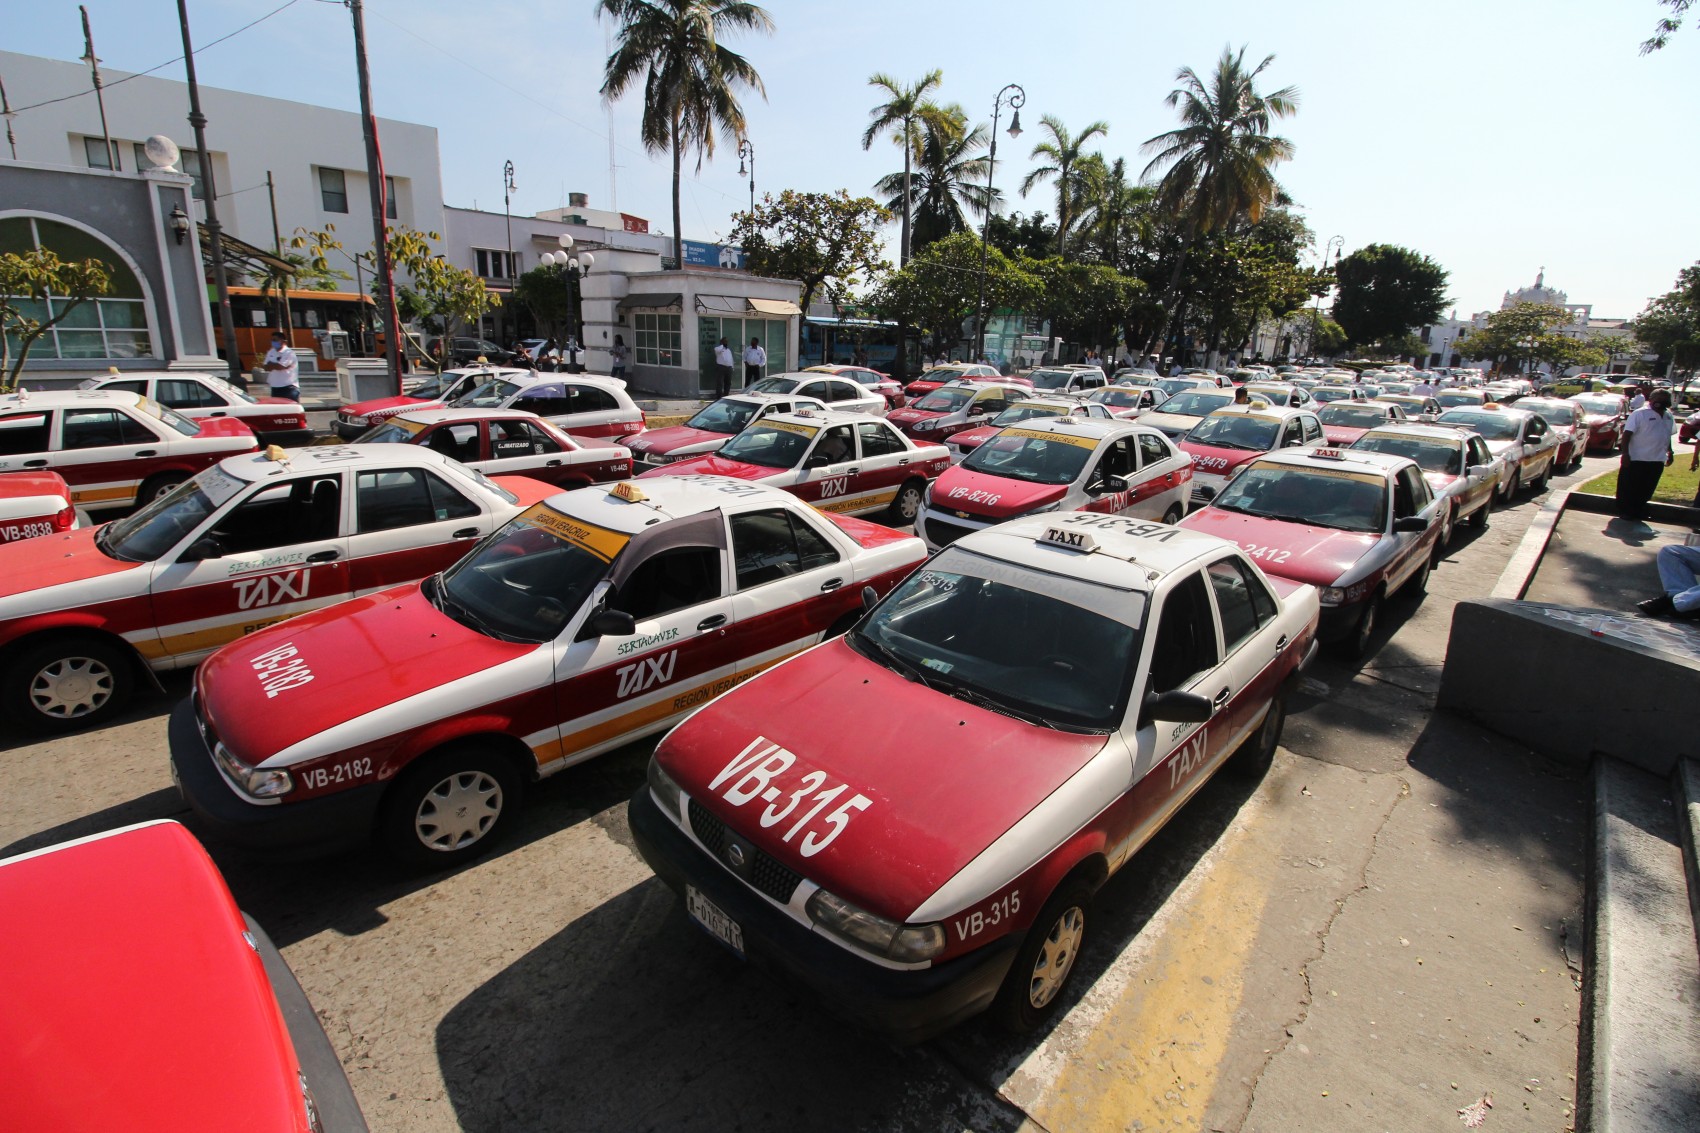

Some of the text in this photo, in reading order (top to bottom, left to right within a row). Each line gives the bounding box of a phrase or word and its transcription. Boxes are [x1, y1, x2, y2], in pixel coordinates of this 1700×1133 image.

[1039, 434, 1079, 444] VERACRUZ
[1315, 448, 1340, 458] TAXI
[616, 483, 631, 498] TAXI
[820, 477, 848, 498] TAXI
[948, 486, 1002, 506] VB-8216
[847, 497, 876, 508] VERACRUZ
[1107, 492, 1128, 514] TAXI
[0, 522, 53, 541] VB-8838
[555, 519, 591, 540] VERACRUZ
[1048, 528, 1085, 547] TAXI
[1062, 514, 1181, 542] VB-315
[232, 568, 311, 610] TAXI
[916, 569, 958, 592] VB-315
[617, 627, 680, 656] SERTACAVER
[250, 641, 315, 699] VB-2182
[616, 649, 678, 699] TAXI
[1168, 727, 1208, 790] TAXI
[302, 757, 373, 790] VB-2182
[707, 735, 874, 858] VB-315
[955, 889, 1021, 942] VB-315
